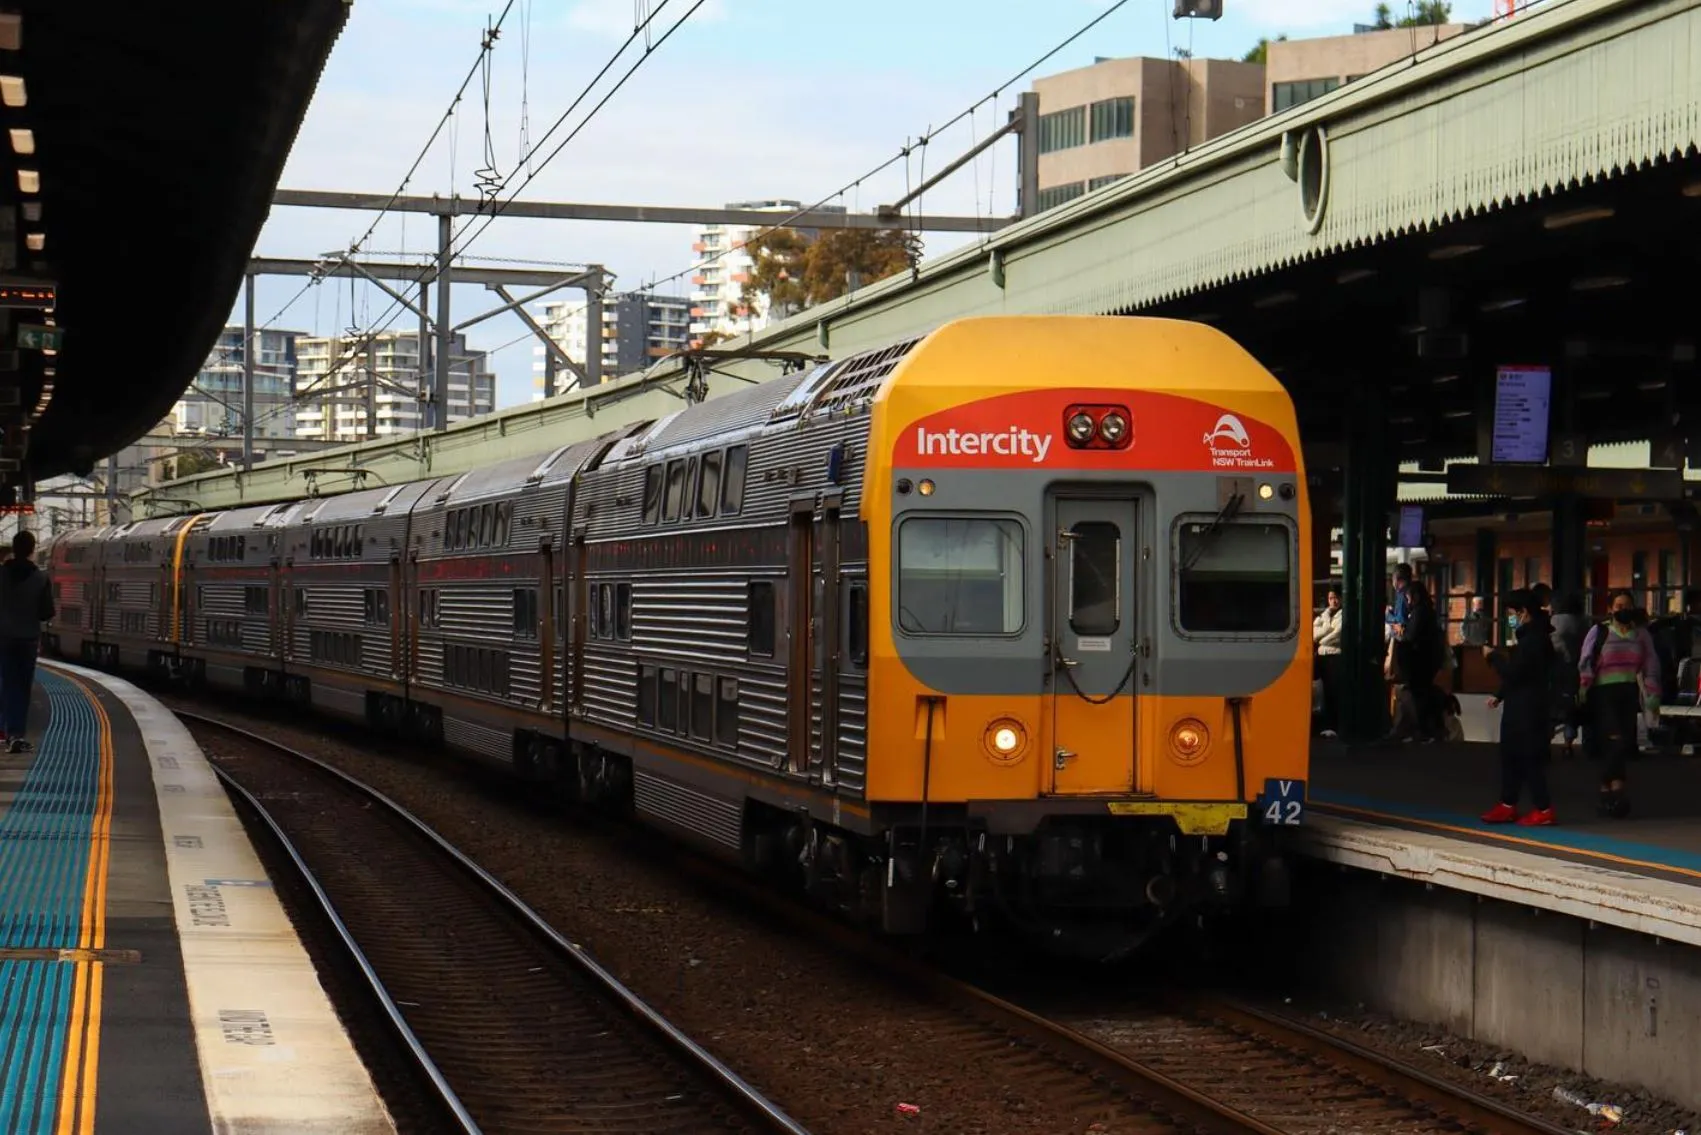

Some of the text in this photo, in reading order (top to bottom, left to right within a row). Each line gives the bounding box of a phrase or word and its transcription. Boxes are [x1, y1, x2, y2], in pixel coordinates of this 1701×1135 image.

[917, 425, 1053, 463] Intercity
[1209, 447, 1252, 458] Transport
[1563, 440, 1575, 458] 3
[1212, 457, 1275, 468] NSW TrainLink
[1279, 780, 1293, 797] V
[1265, 800, 1302, 825] 42
